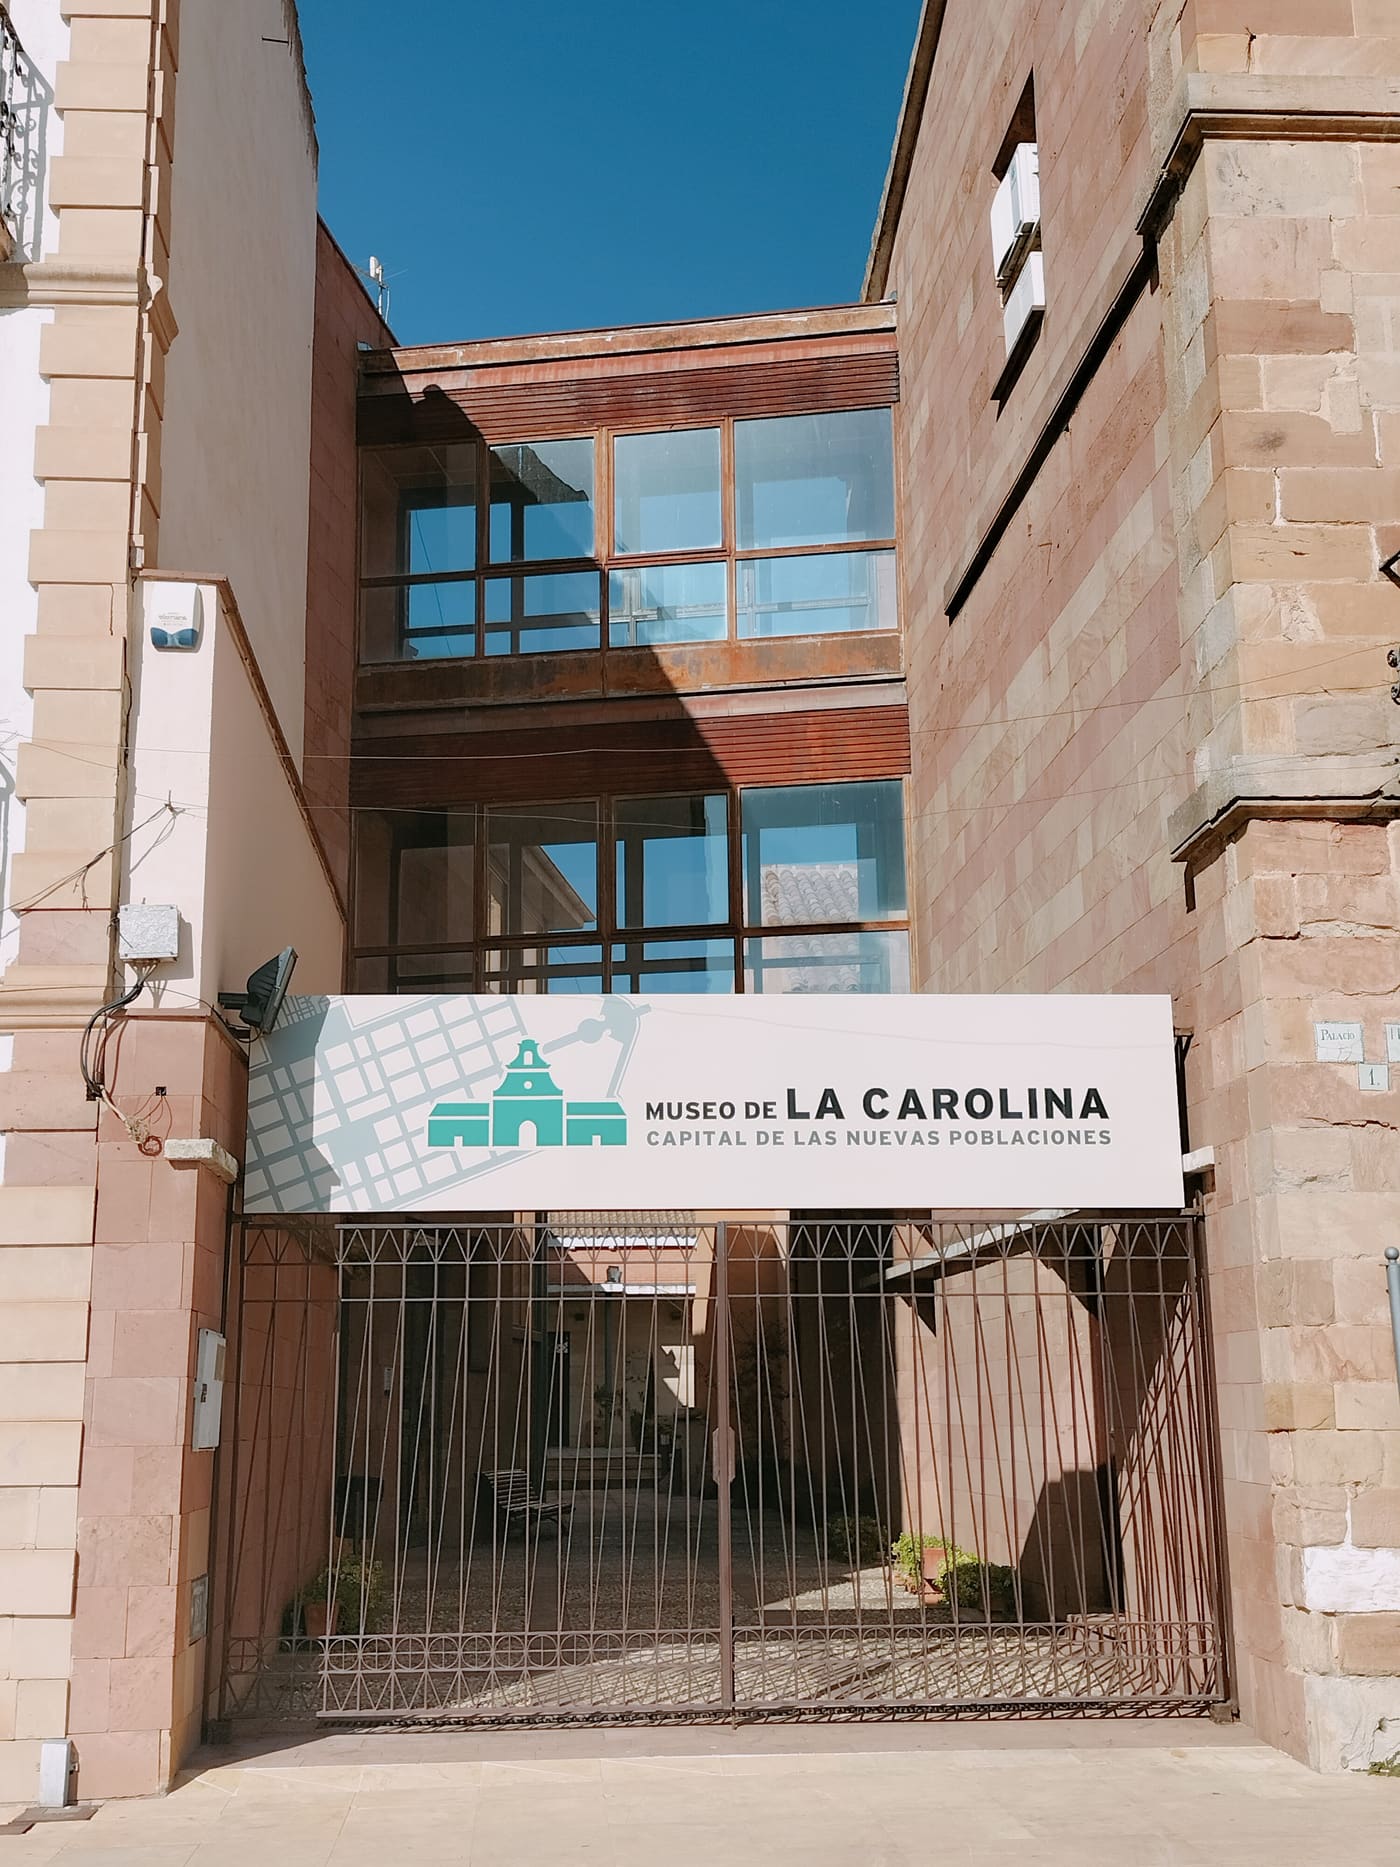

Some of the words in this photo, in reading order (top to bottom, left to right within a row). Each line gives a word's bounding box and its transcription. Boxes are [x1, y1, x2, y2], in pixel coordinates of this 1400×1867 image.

[645, 1101, 736, 1121] MUSEO
[744, 1101, 777, 1120] DE
[786, 1087, 845, 1120] LA
[862, 1087, 1110, 1120] CAROLINA
[646, 1130, 747, 1147] CAPITAL
[756, 1130, 785, 1146] DE
[793, 1130, 837, 1146] LAS
[846, 1130, 940, 1146] NUEVAS
[949, 1129, 1112, 1146] POBLACIONES
